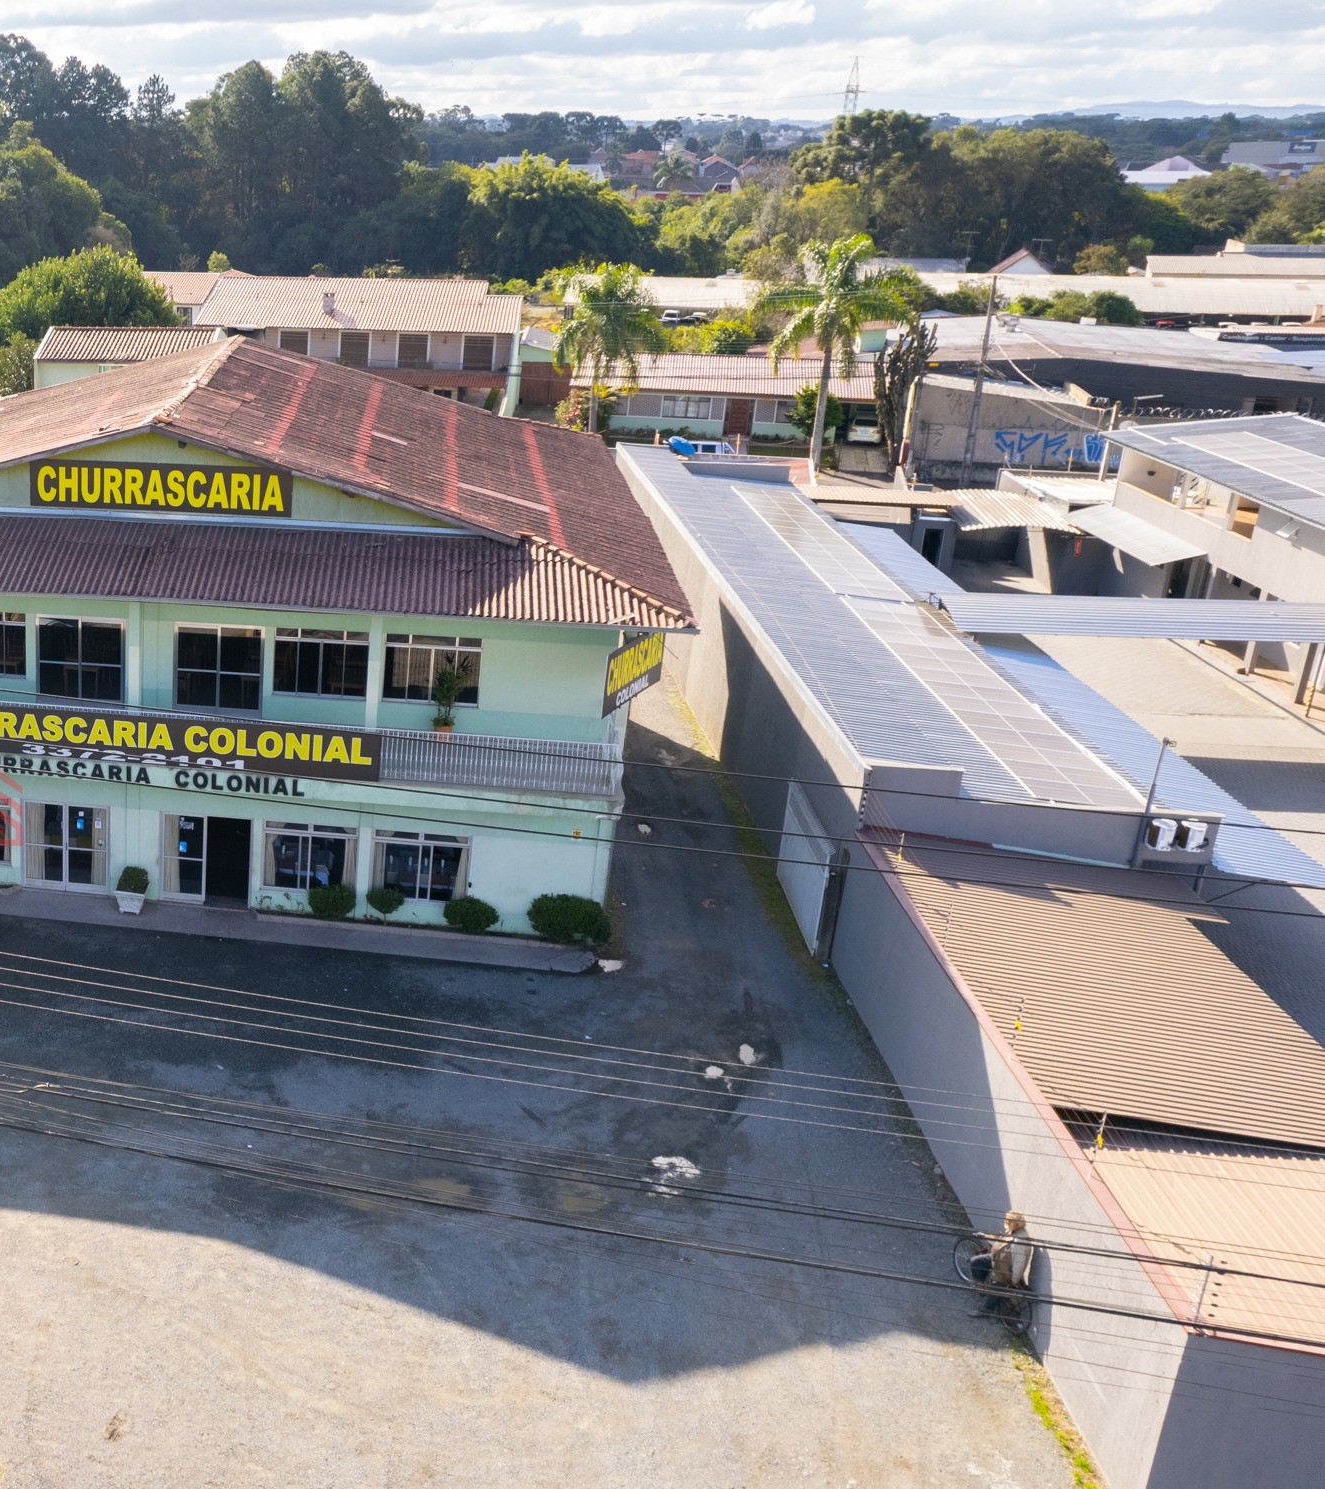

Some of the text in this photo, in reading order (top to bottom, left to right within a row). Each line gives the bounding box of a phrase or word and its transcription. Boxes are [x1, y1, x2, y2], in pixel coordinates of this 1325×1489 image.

[37, 465, 284, 512] CHURRASCARIA
[606, 631, 664, 697] CHURRASCARIA
[615, 674, 649, 707] COLONIAL
[184, 725, 372, 766] COLONIAL
[175, 770, 305, 797] COLONIAL
